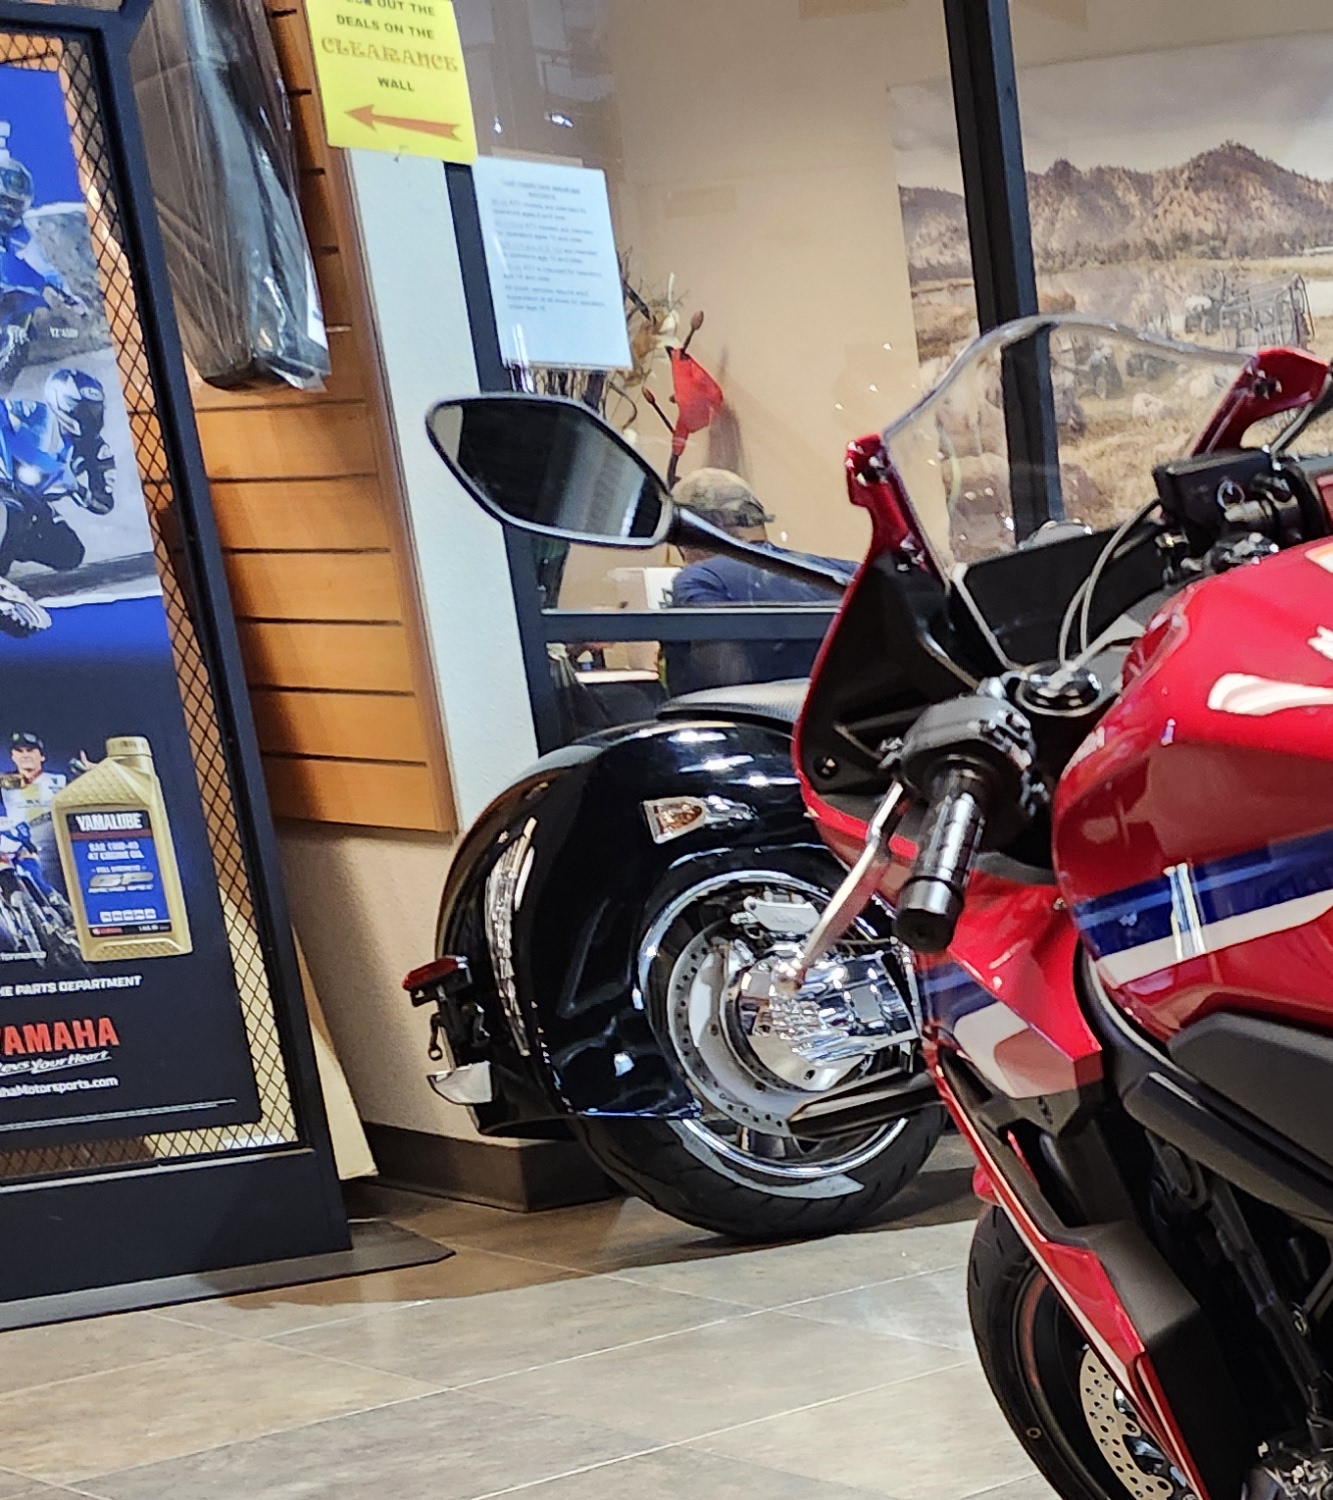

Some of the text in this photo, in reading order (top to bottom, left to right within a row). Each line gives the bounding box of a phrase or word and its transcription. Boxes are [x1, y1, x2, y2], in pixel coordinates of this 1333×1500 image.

[411, 3, 436, 16] THE
[336, 14, 435, 39] DEALS ON THE
[321, 36, 459, 72] CLEARANCE
[378, 76, 416, 92] WALL
[75, 812, 143, 832] YAMALUBE
[15, 981, 57, 996] PARTS
[58, 974, 143, 992] DEPARTMENT
[0, 1017, 120, 1056] AMAHA
[31, 1058, 68, 1074] Your
[67, 1050, 110, 1066] Heart
